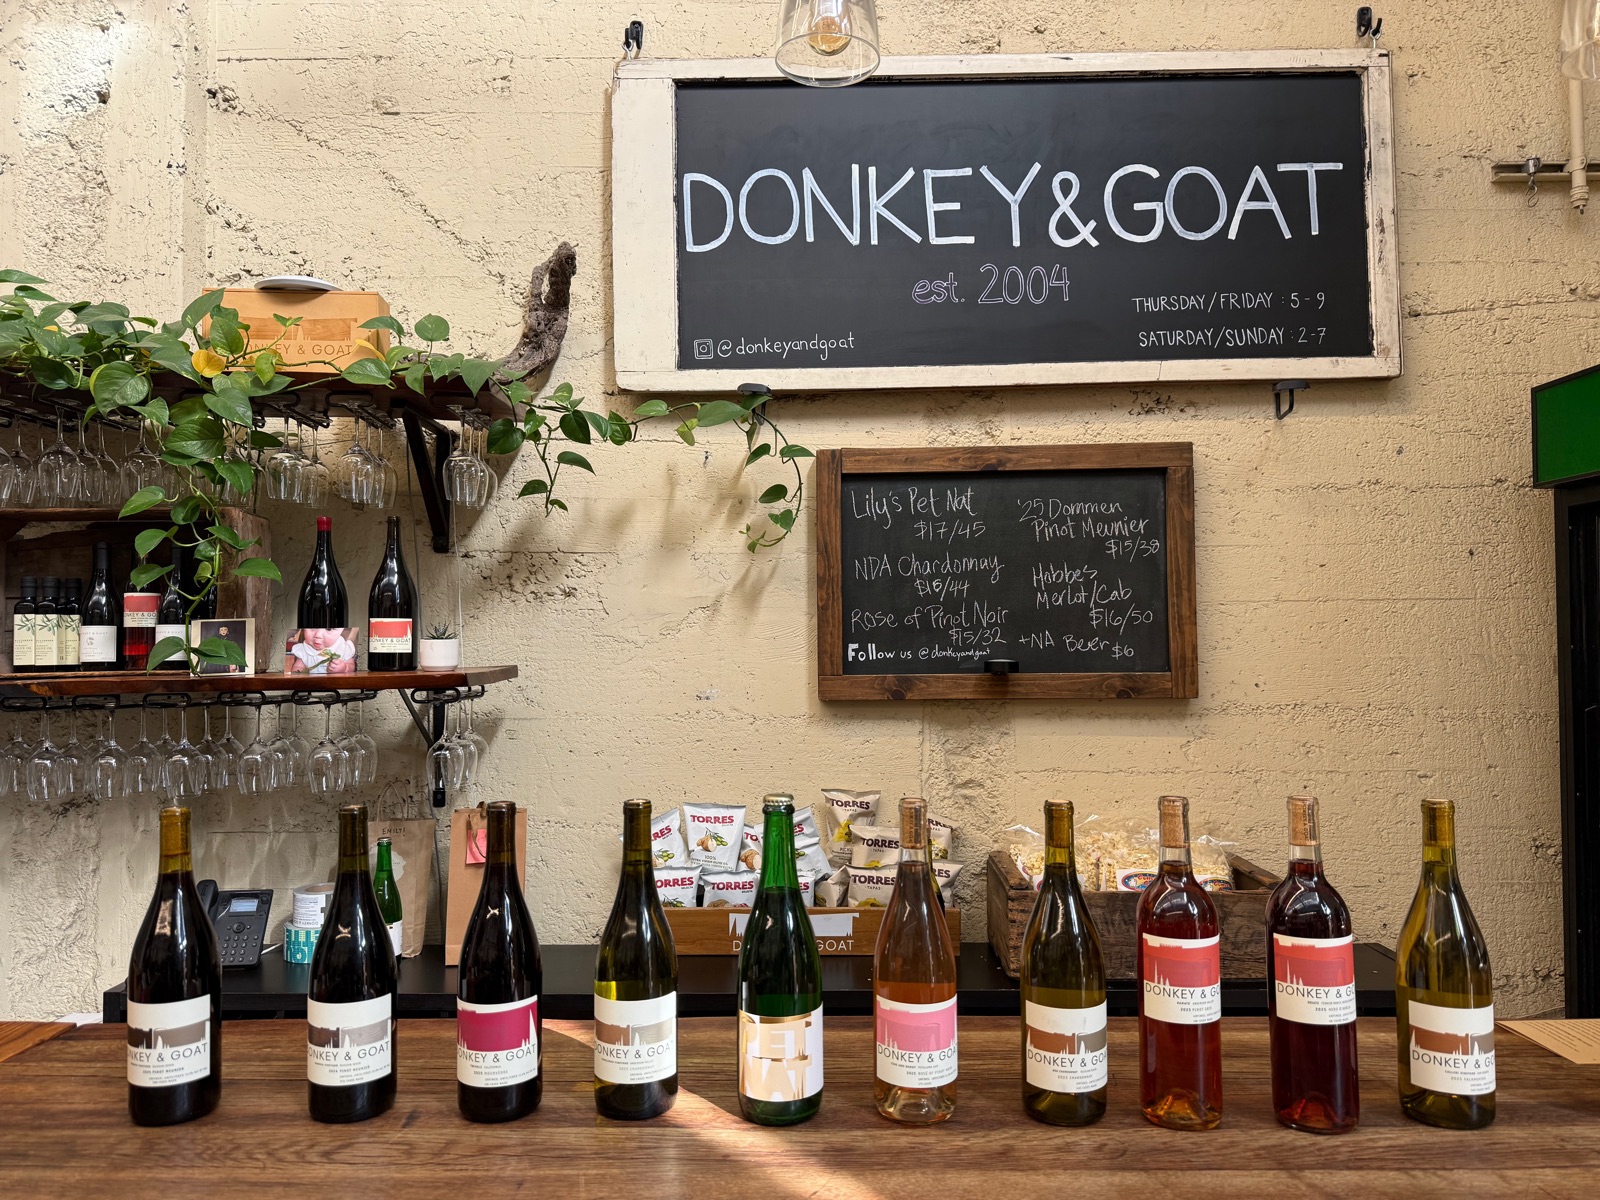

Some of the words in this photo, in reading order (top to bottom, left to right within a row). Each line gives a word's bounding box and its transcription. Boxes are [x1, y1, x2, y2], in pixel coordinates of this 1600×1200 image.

[912, 272, 966, 304] est.
[977, 262, 1070, 305] 2004
[1131, 291, 1274, 313] THURSDAY/FRIDAY
[1137, 326, 1285, 349] SATURDAY/SUNDAY
[297, 344, 306, 355] &
[311, 344, 353, 356] GOAT
[850, 486, 903, 530] Lily's
[908, 486, 943, 518] Pet
[946, 486, 978, 517] Nat
[1048, 498, 1123, 520] Dommen
[913, 519, 986, 545] $17/45
[1030, 515, 1076, 543] Pinot
[1081, 515, 1150, 539] Meunier
[1104, 535, 1160, 563] $15/38
[854, 553, 892, 581] NDA
[897, 550, 1005, 584] Chardonnay
[1031, 559, 1098, 591] Hobbes
[1036, 577, 1133, 610] Merlot/Cab
[903, 605, 923, 630] of
[924, 601, 970, 630] Pinot
[973, 599, 1009, 628] Noir
[1088, 602, 1154, 636] $16/50
[948, 624, 1008, 647] $15/32
[1018, 629, 1055, 650] +NA
[1062, 634, 1110, 652] Beer
[1111, 641, 1135, 661] $6
[847, 643, 896, 662] Follow
[900, 649, 913, 660] us
[829, 798, 871, 811] TORRES
[690, 814, 735, 825] TORRES
[860, 837, 900, 849] TORRES
[711, 880, 754, 892] TORRES
[851, 873, 897, 886] TORRES
[815, 939, 855, 951] GOAT
[1145, 982, 1196, 999] DONKEY
[1200, 989, 1207, 999] &
[1277, 982, 1331, 999] DONKEY
[1335, 988, 1342, 998] &
[156, 1052, 165, 1063] &
[170, 1042, 208, 1061] GOAT
[344, 1051, 352, 1062] &
[357, 1040, 390, 1060] GOAT
[492, 1053, 500, 1063] &
[505, 1043, 536, 1062] GOAT
[634, 1049, 642, 1059] &
[877, 1043, 923, 1063] DONKEY
[927, 1053, 935, 1063] &
[1027, 1048, 1076, 1068] DONKEY
[1079, 1057, 1087, 1068] &
[1412, 1049, 1470, 1069] DONKEY
[1474, 1058, 1481, 1069] &
